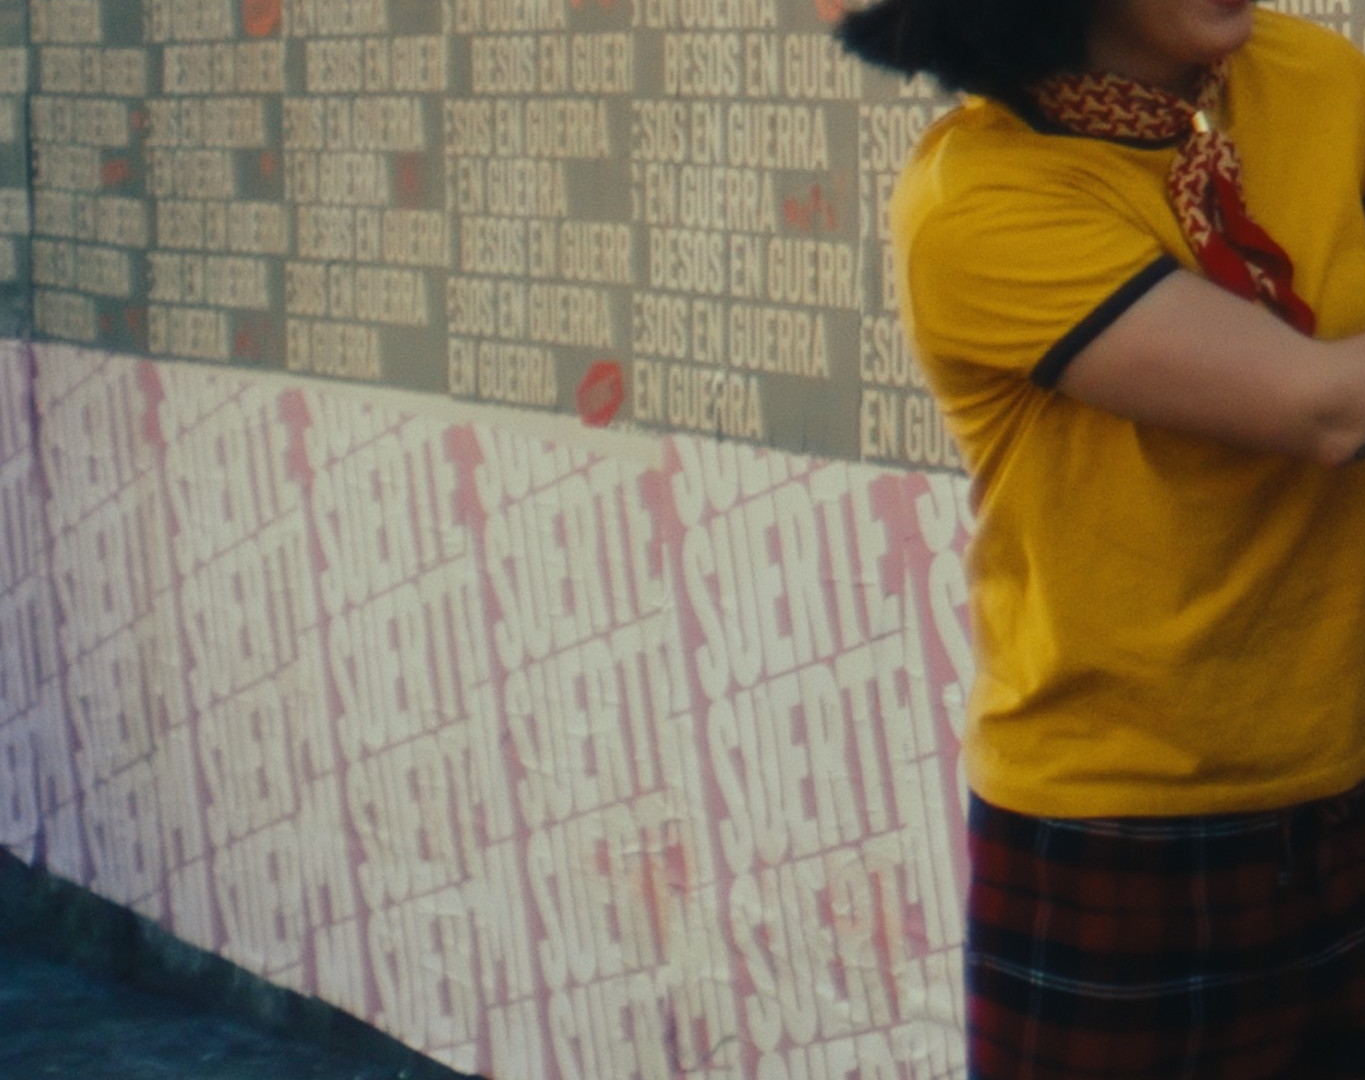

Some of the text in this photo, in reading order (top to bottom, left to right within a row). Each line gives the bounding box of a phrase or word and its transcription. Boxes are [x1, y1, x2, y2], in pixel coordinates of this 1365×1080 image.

[664, 32, 740, 98] BESOS
[728, 101, 828, 170] GUERRA
[729, 302, 830, 378] GUERRA
[668, 363, 764, 440] GUERRA
[861, 389, 899, 460] EN
[484, 458, 672, 671] SUERTE
[683, 461, 903, 701] SUERTE
